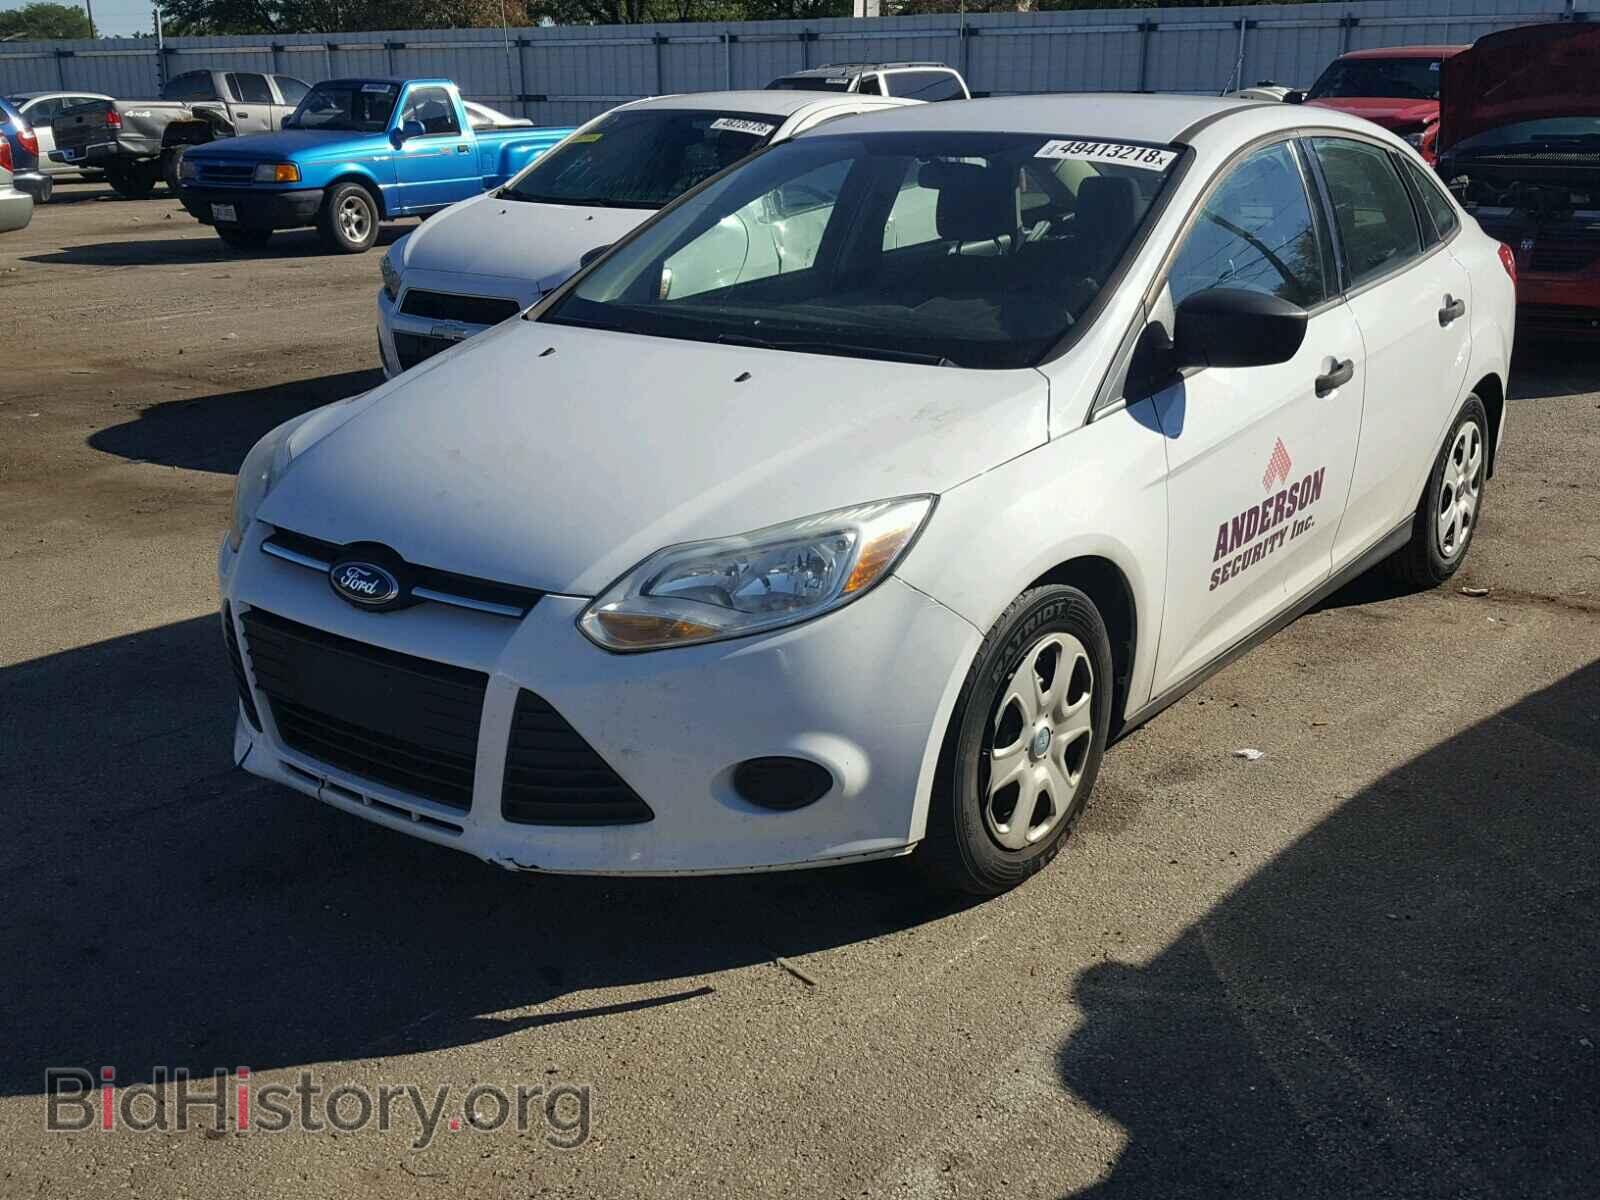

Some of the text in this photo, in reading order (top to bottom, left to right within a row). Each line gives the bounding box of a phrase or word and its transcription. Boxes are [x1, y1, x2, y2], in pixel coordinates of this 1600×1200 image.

[1209, 515, 1316, 592] SECURITY Inc.
[1213, 467, 1326, 563] ANDERSON
[340, 566, 379, 595] Ford
